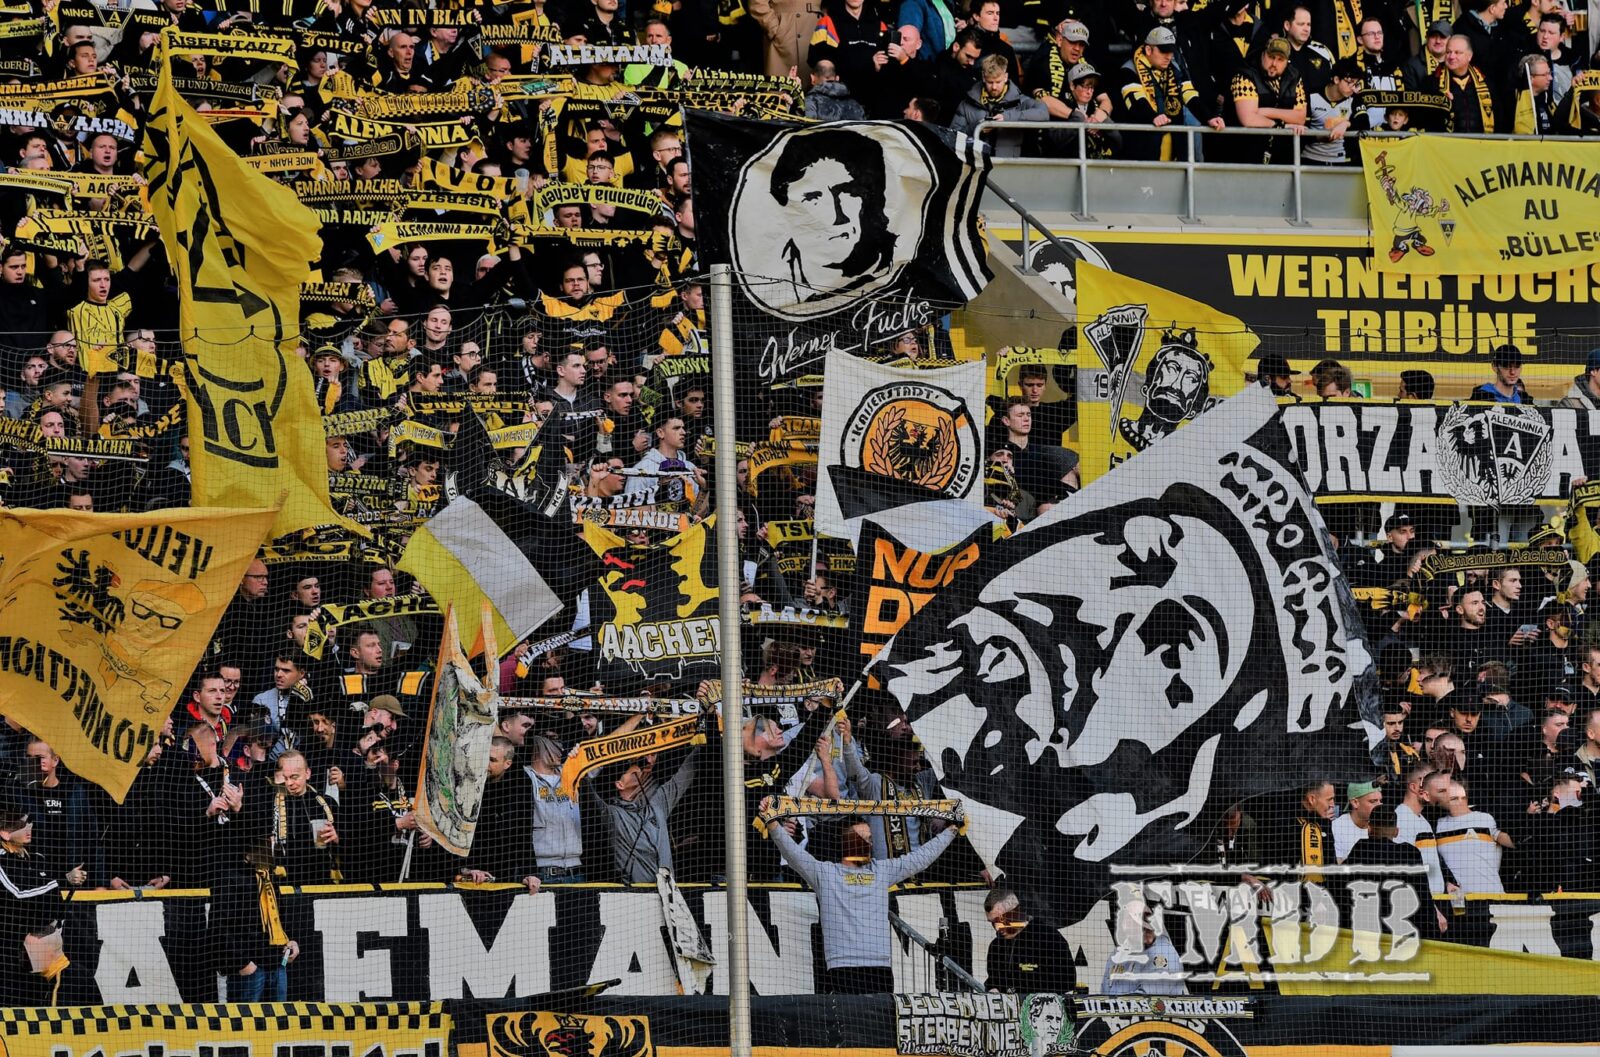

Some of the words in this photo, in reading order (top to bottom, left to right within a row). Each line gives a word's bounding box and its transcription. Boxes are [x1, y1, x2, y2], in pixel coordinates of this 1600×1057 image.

[61, 8, 94, 18] MINGE
[134, 14, 169, 26] VEREIN
[408, 9, 427, 25] IN
[432, 9, 477, 25] BLAC
[301, 32, 364, 53] Jonge
[188, 80, 209, 91] UND
[567, 104, 600, 112] MINGE
[639, 105, 673, 117] VEREIN
[269, 157, 293, 168] HAHN
[1524, 199, 1559, 220] AU
[1228, 253, 1442, 300] WERNER
[1463, 265, 1600, 303] FUCH
[759, 326, 841, 383] Werner
[851, 287, 934, 352] Fuchs
[1317, 303, 1538, 355] TRIBÜNE
[659, 356, 710, 378] AACHEN
[851, 384, 933, 437] KAISERSTADT
[1491, 415, 1544, 434] ALEMANNIA
[87, 439, 133, 455] AACHEN
[1279, 406, 1447, 495] ORZA
[752, 448, 789, 468] AACHEN
[336, 479, 388, 491] BAYERN
[615, 509, 680, 530] BANDE
[1431, 551, 1505, 571] Alemannia
[1510, 548, 1566, 563] Aachen
[94, 893, 1118, 1003] AEMANNIA
[896, 993, 1019, 1022] LEGENDEN
[1083, 999, 1149, 1014] ULTRAS
[1164, 1000, 1247, 1015] KERKRADE
[899, 1017, 982, 1047] STERBEN
